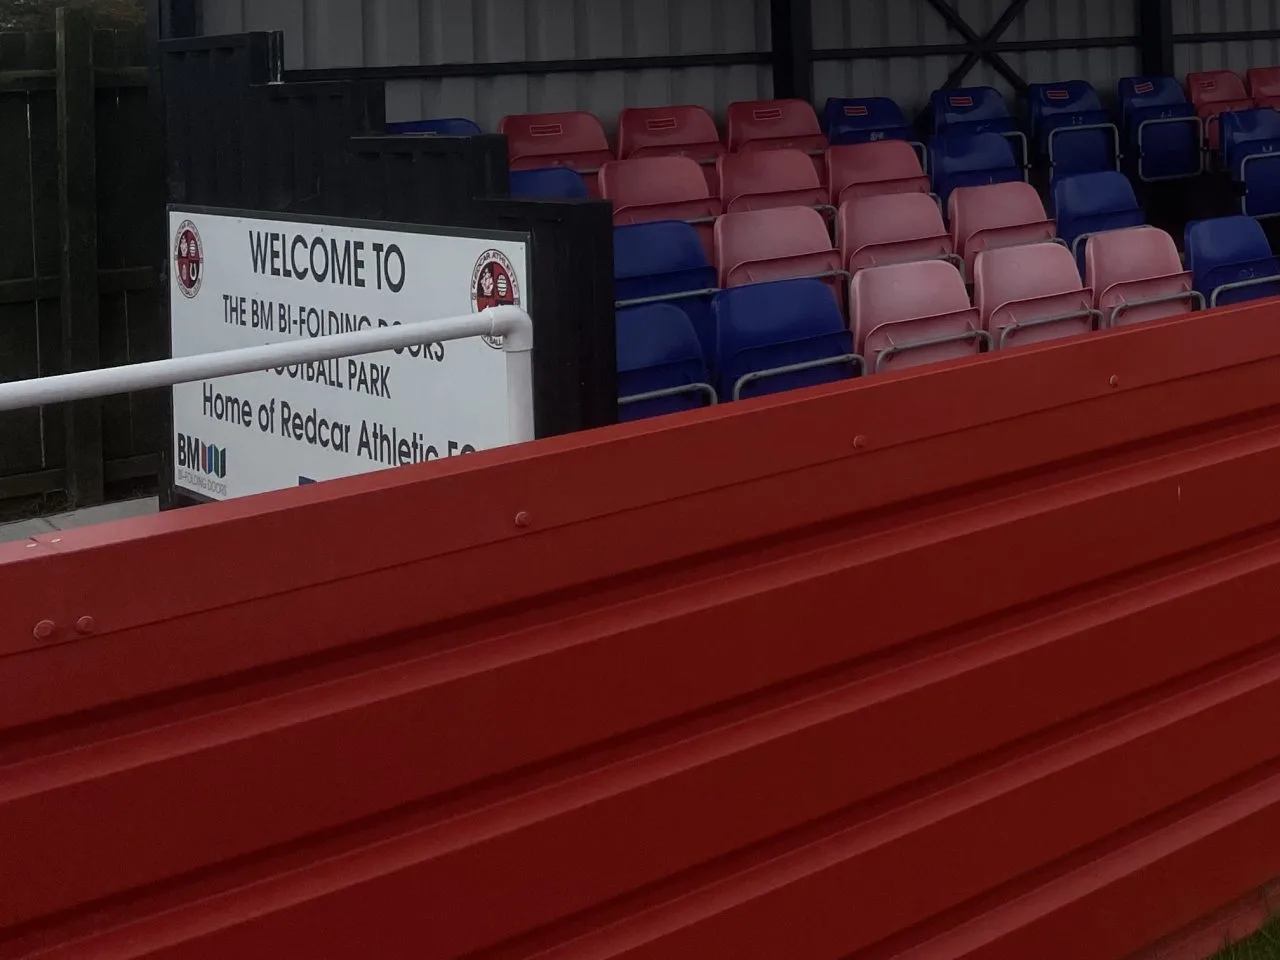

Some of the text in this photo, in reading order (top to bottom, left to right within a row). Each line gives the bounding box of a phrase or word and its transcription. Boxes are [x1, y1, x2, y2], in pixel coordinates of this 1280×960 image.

[249, 230, 366, 288] WELCOME
[372, 242, 406, 293] TO
[223, 294, 247, 327] THE
[251, 299, 274, 332] BM
[348, 358, 392, 400] PARK
[202, 383, 439, 467] Home of Redcar Athletic
[177, 432, 200, 472] BM
